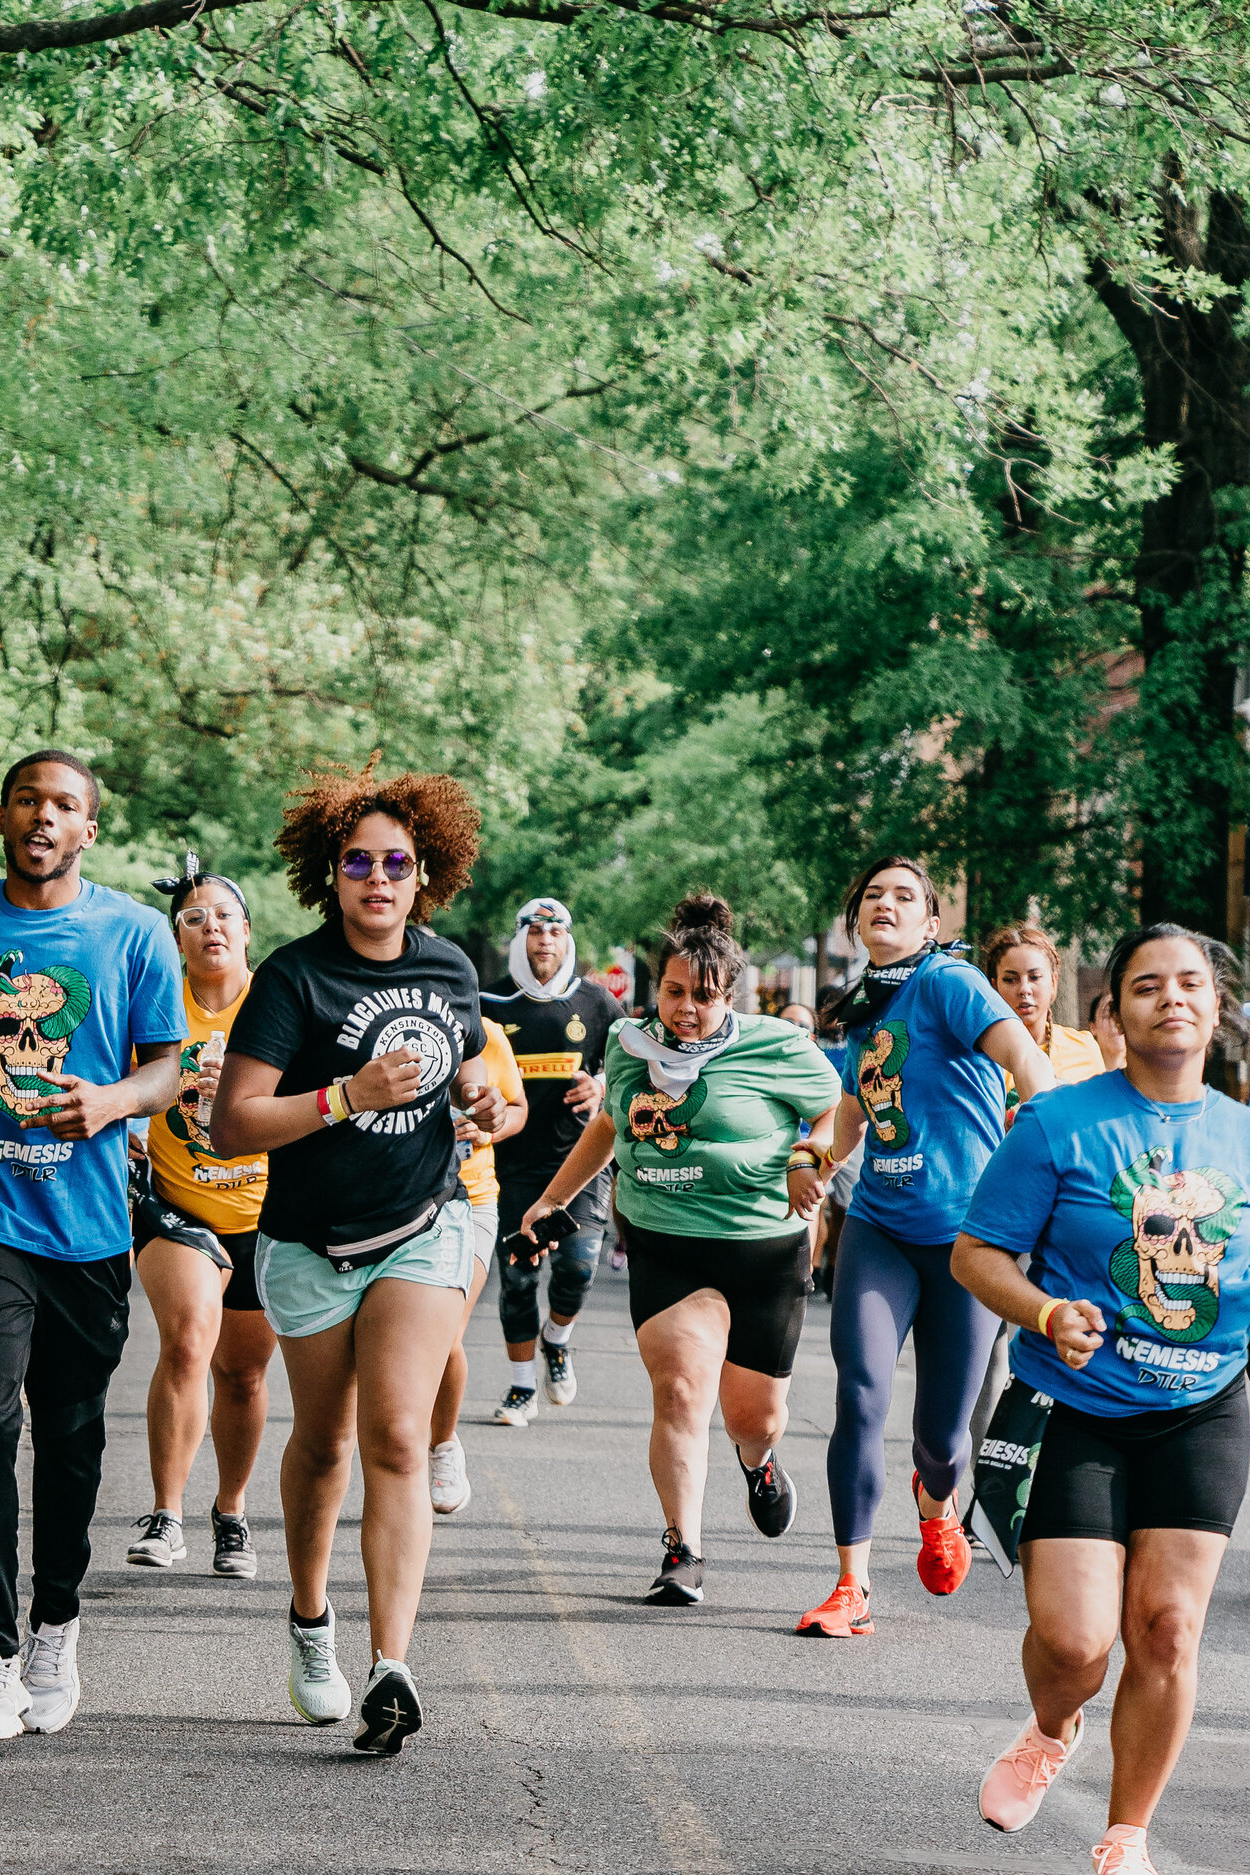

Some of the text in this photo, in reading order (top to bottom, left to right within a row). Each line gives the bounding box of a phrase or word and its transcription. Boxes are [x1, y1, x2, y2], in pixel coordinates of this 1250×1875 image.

[372, 986, 424, 1012] LIVES
[379, 1019, 446, 1047] KENSINGTON
[406, 1042, 428, 1053] SC
[520, 1060, 574, 1074] IRELLI
[11, 1161, 58, 1183] DTLR
[636, 1165, 704, 1183] NEMESIS
[872, 1153, 924, 1174] NEMESIS
[1116, 1336, 1222, 1373] NEMESIS
[1137, 1366, 1200, 1392] DTLR
